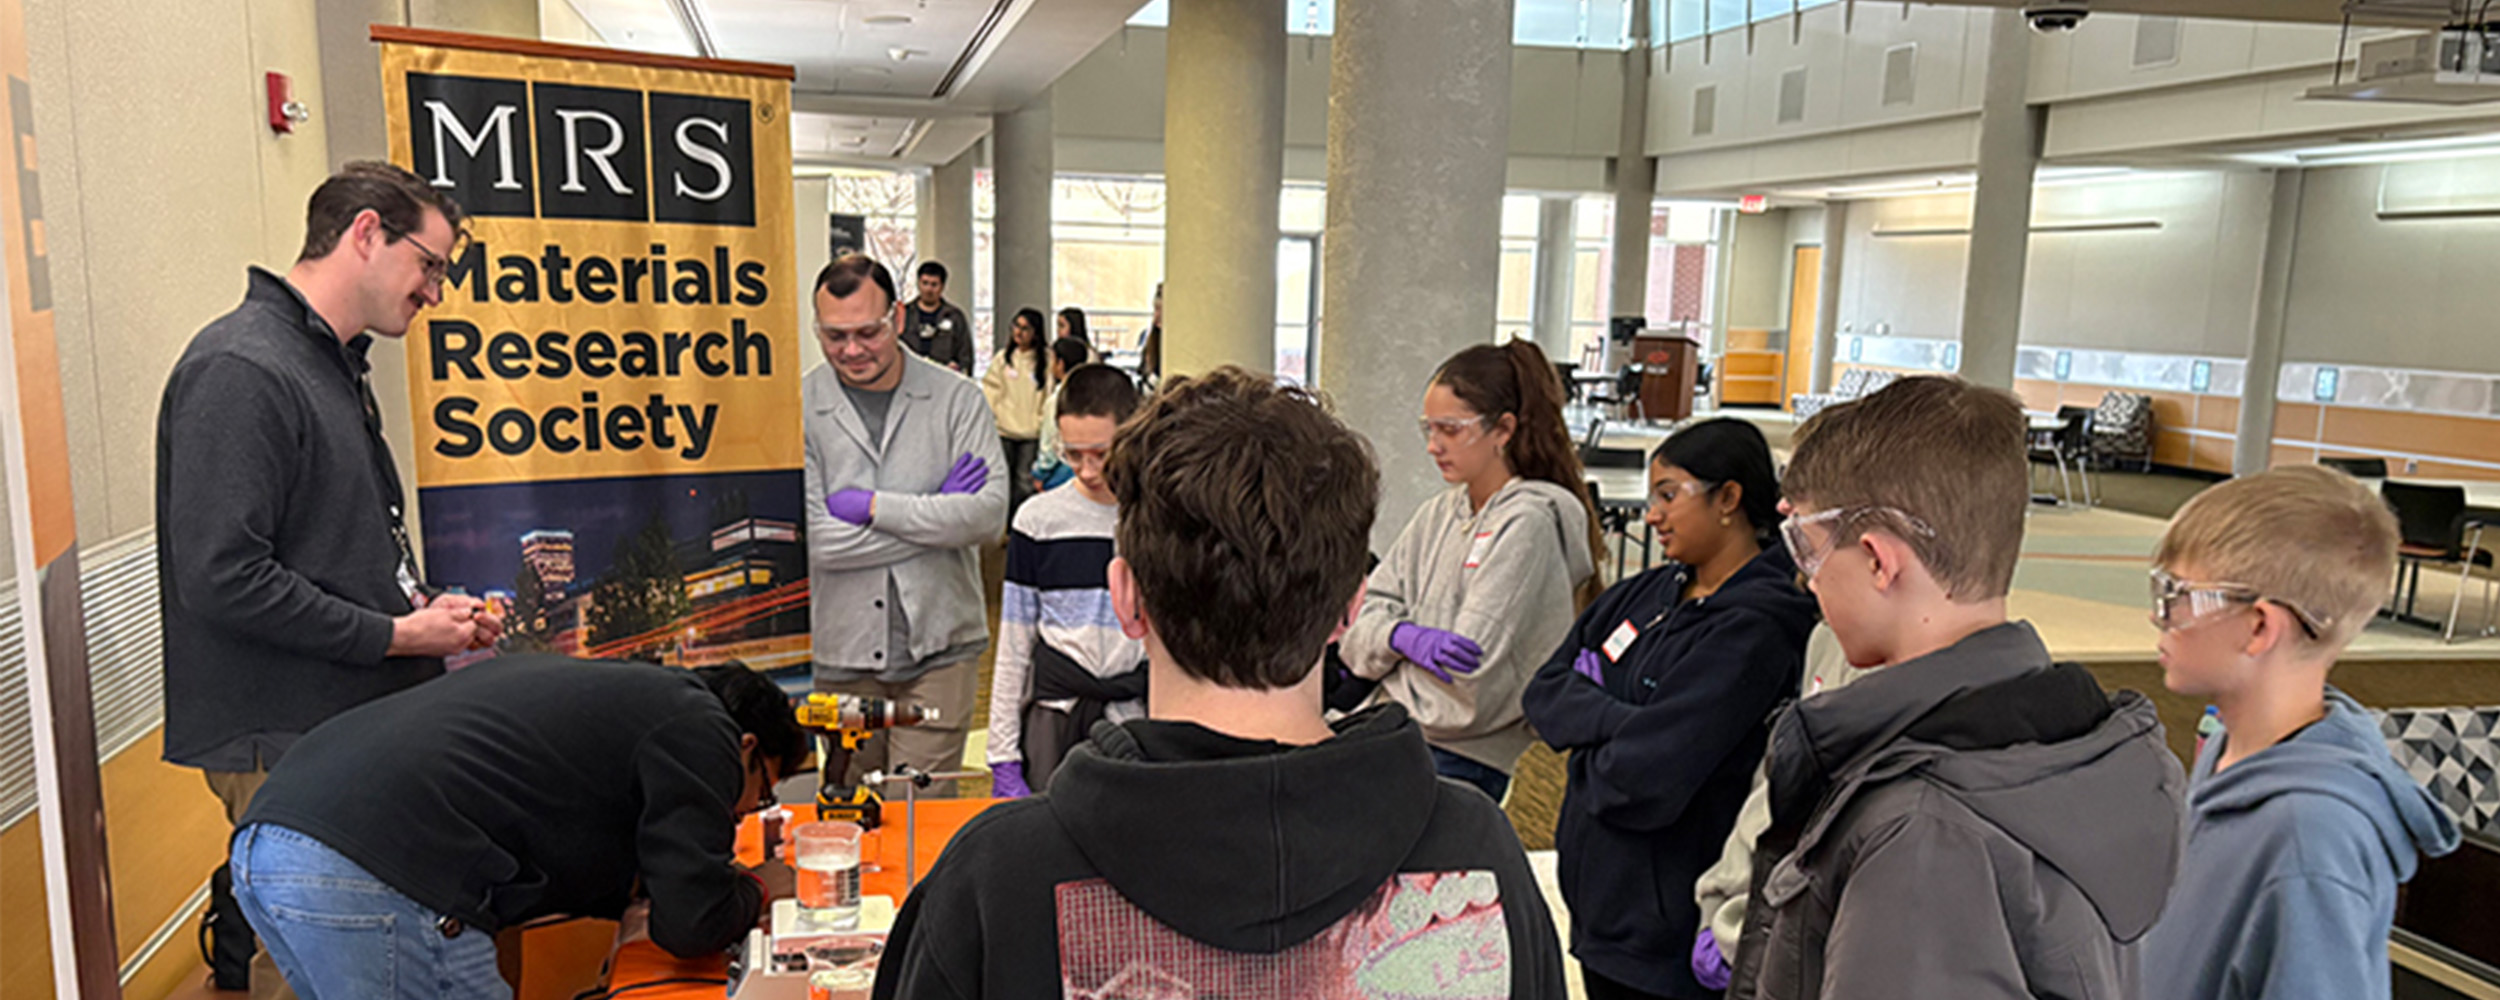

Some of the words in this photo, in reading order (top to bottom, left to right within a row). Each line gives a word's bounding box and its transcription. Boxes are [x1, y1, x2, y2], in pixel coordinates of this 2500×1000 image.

[424, 101, 732, 200] MRS
[440, 242, 769, 306] Materials
[428, 318, 772, 380] Research
[433, 391, 719, 460] Society
